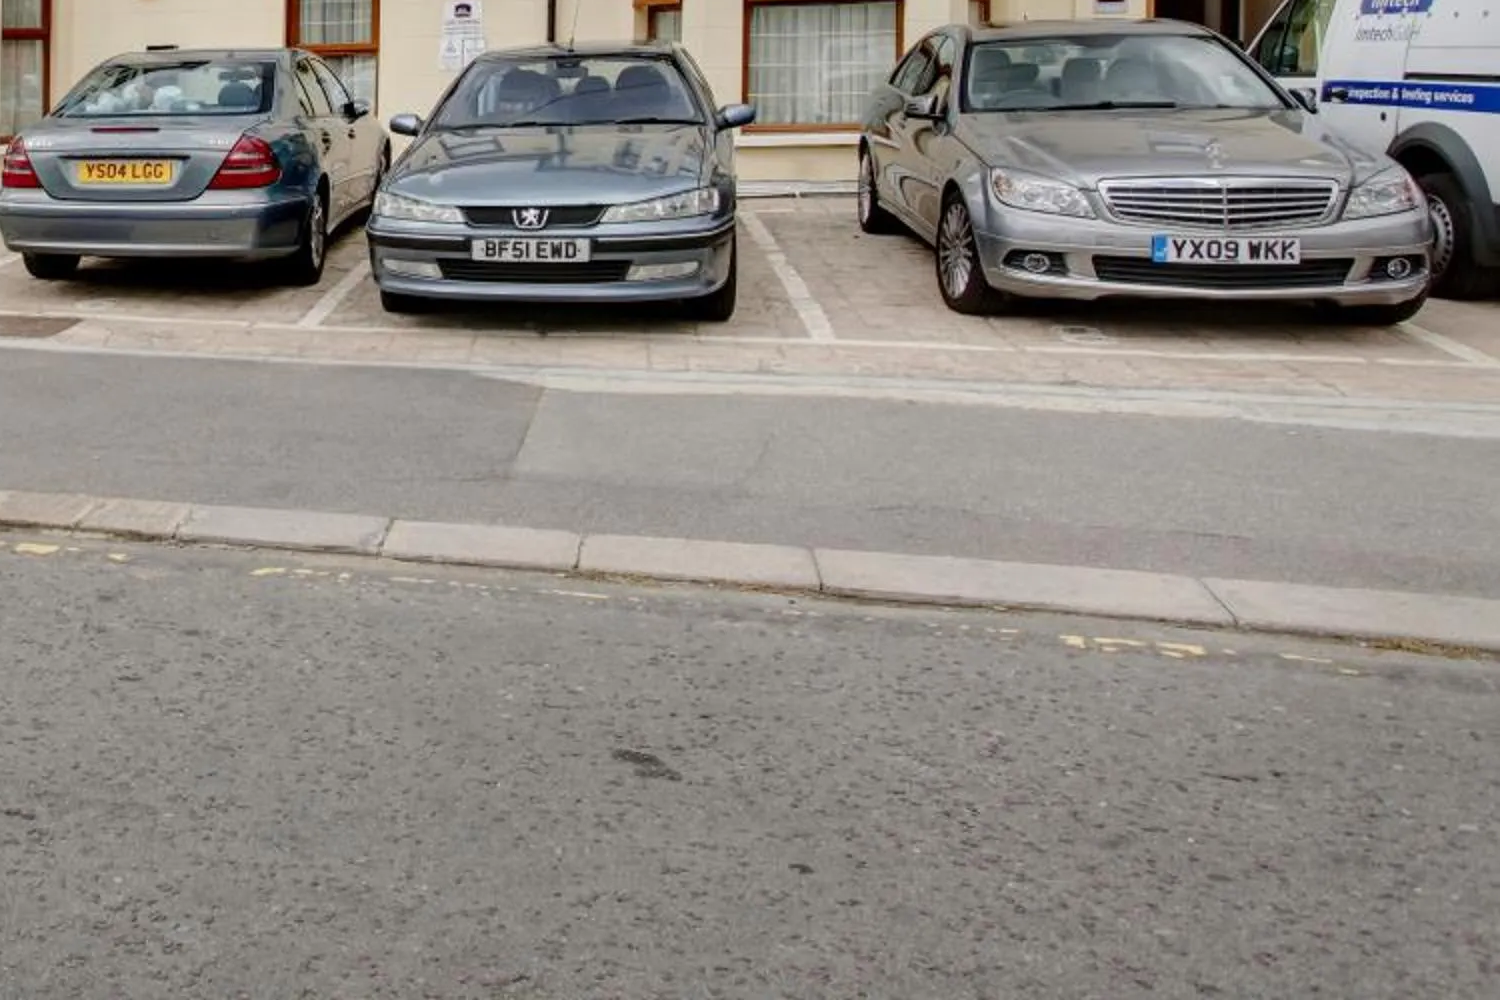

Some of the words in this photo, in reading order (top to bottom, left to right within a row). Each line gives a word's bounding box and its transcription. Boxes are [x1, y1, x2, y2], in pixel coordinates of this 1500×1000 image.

[1433, 89, 1475, 105] services
[84, 161, 127, 180] YS04
[485, 241, 529, 259] BF51
[536, 241, 577, 259] EWD
[1172, 239, 1239, 260] YX09
[1247, 239, 1296, 261] WKK
